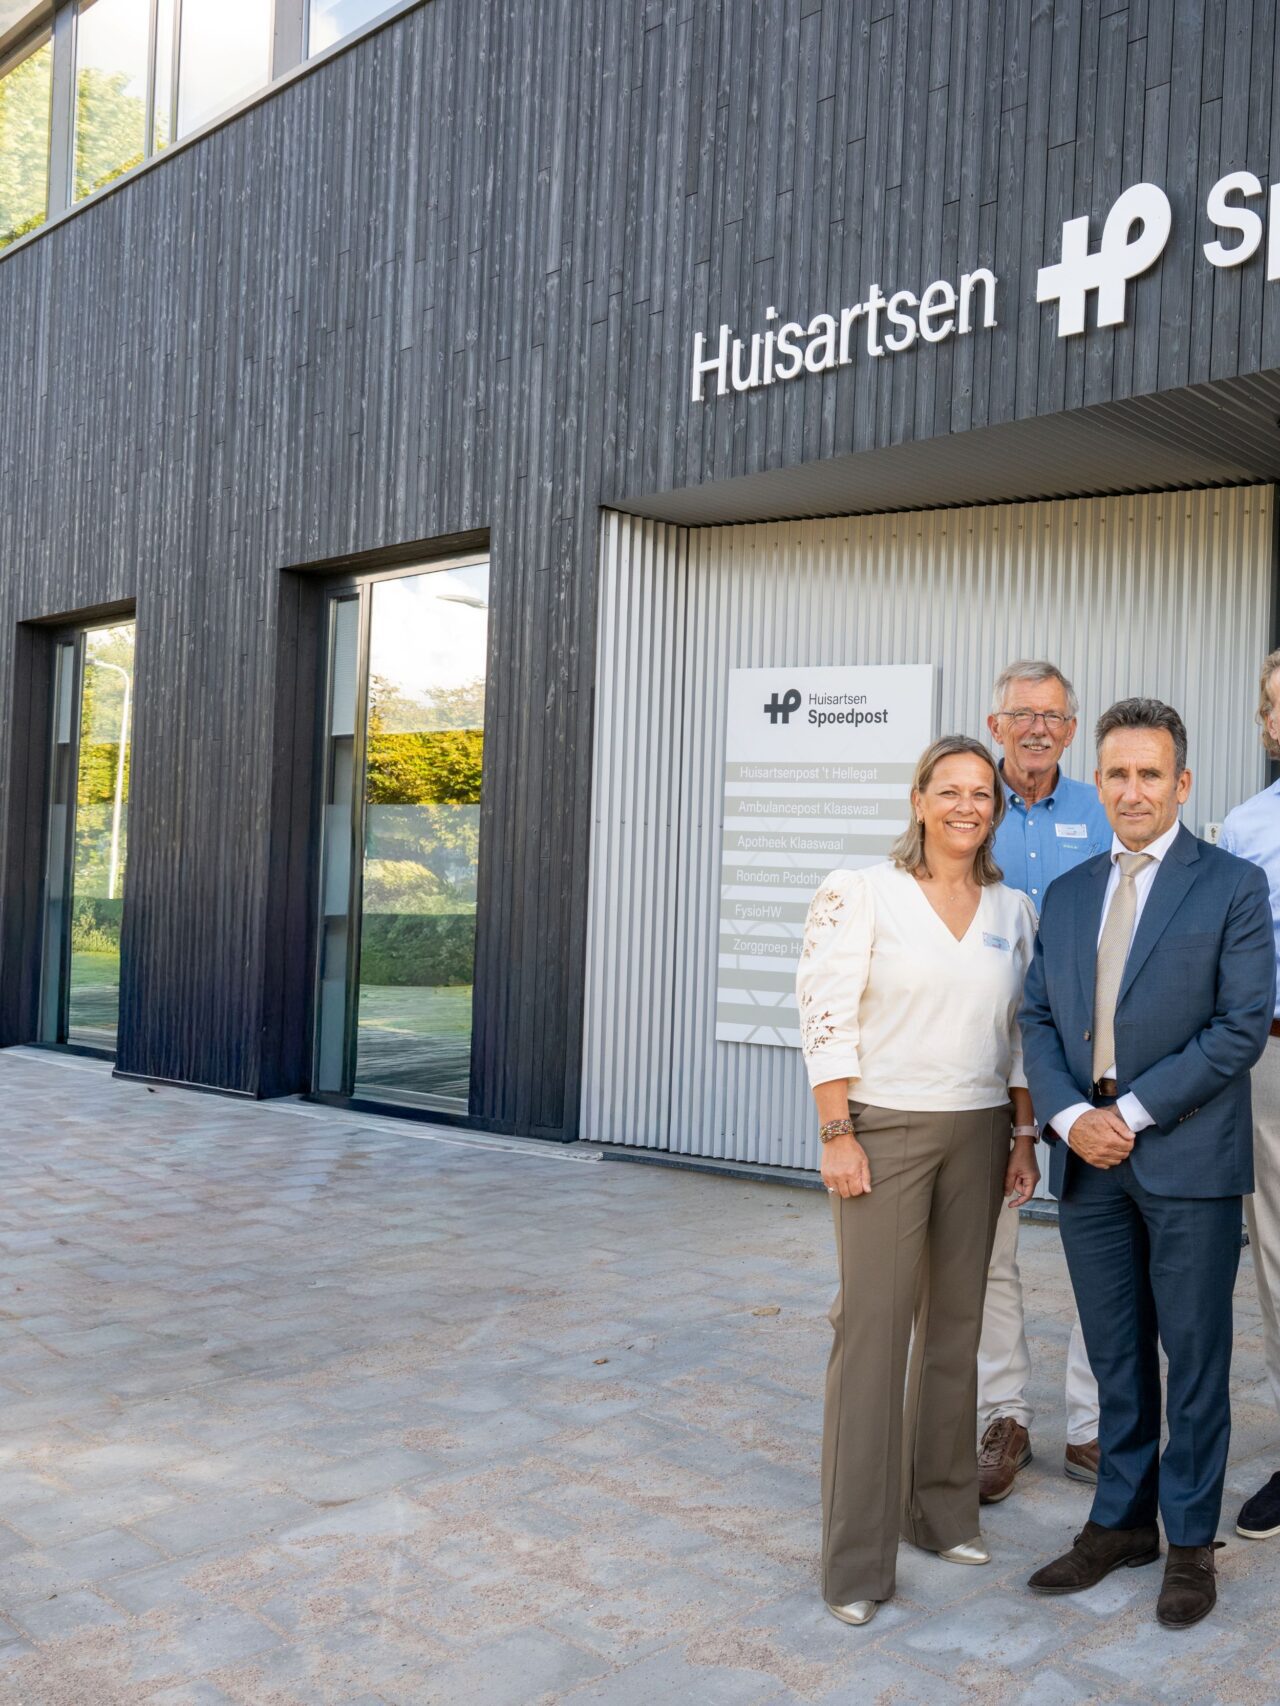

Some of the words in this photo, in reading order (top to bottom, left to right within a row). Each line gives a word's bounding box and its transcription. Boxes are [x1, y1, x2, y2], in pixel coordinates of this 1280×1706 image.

[692, 268, 996, 401] Huisartsen
[808, 692, 867, 705] Huisartsen
[808, 708, 888, 728] Spoedpost
[740, 766, 819, 782] Huisartsenpost
[832, 767, 877, 782] Hellegat
[738, 801, 820, 816] Ambulancepost
[824, 802, 879, 816] Klaaswaal
[737, 835, 787, 849] Apotheek
[790, 837, 844, 850] Klaaswaal
[736, 869, 780, 883] Rondom
[735, 903, 782, 919] FysioHW
[733, 938, 788, 955] Zorggroep
